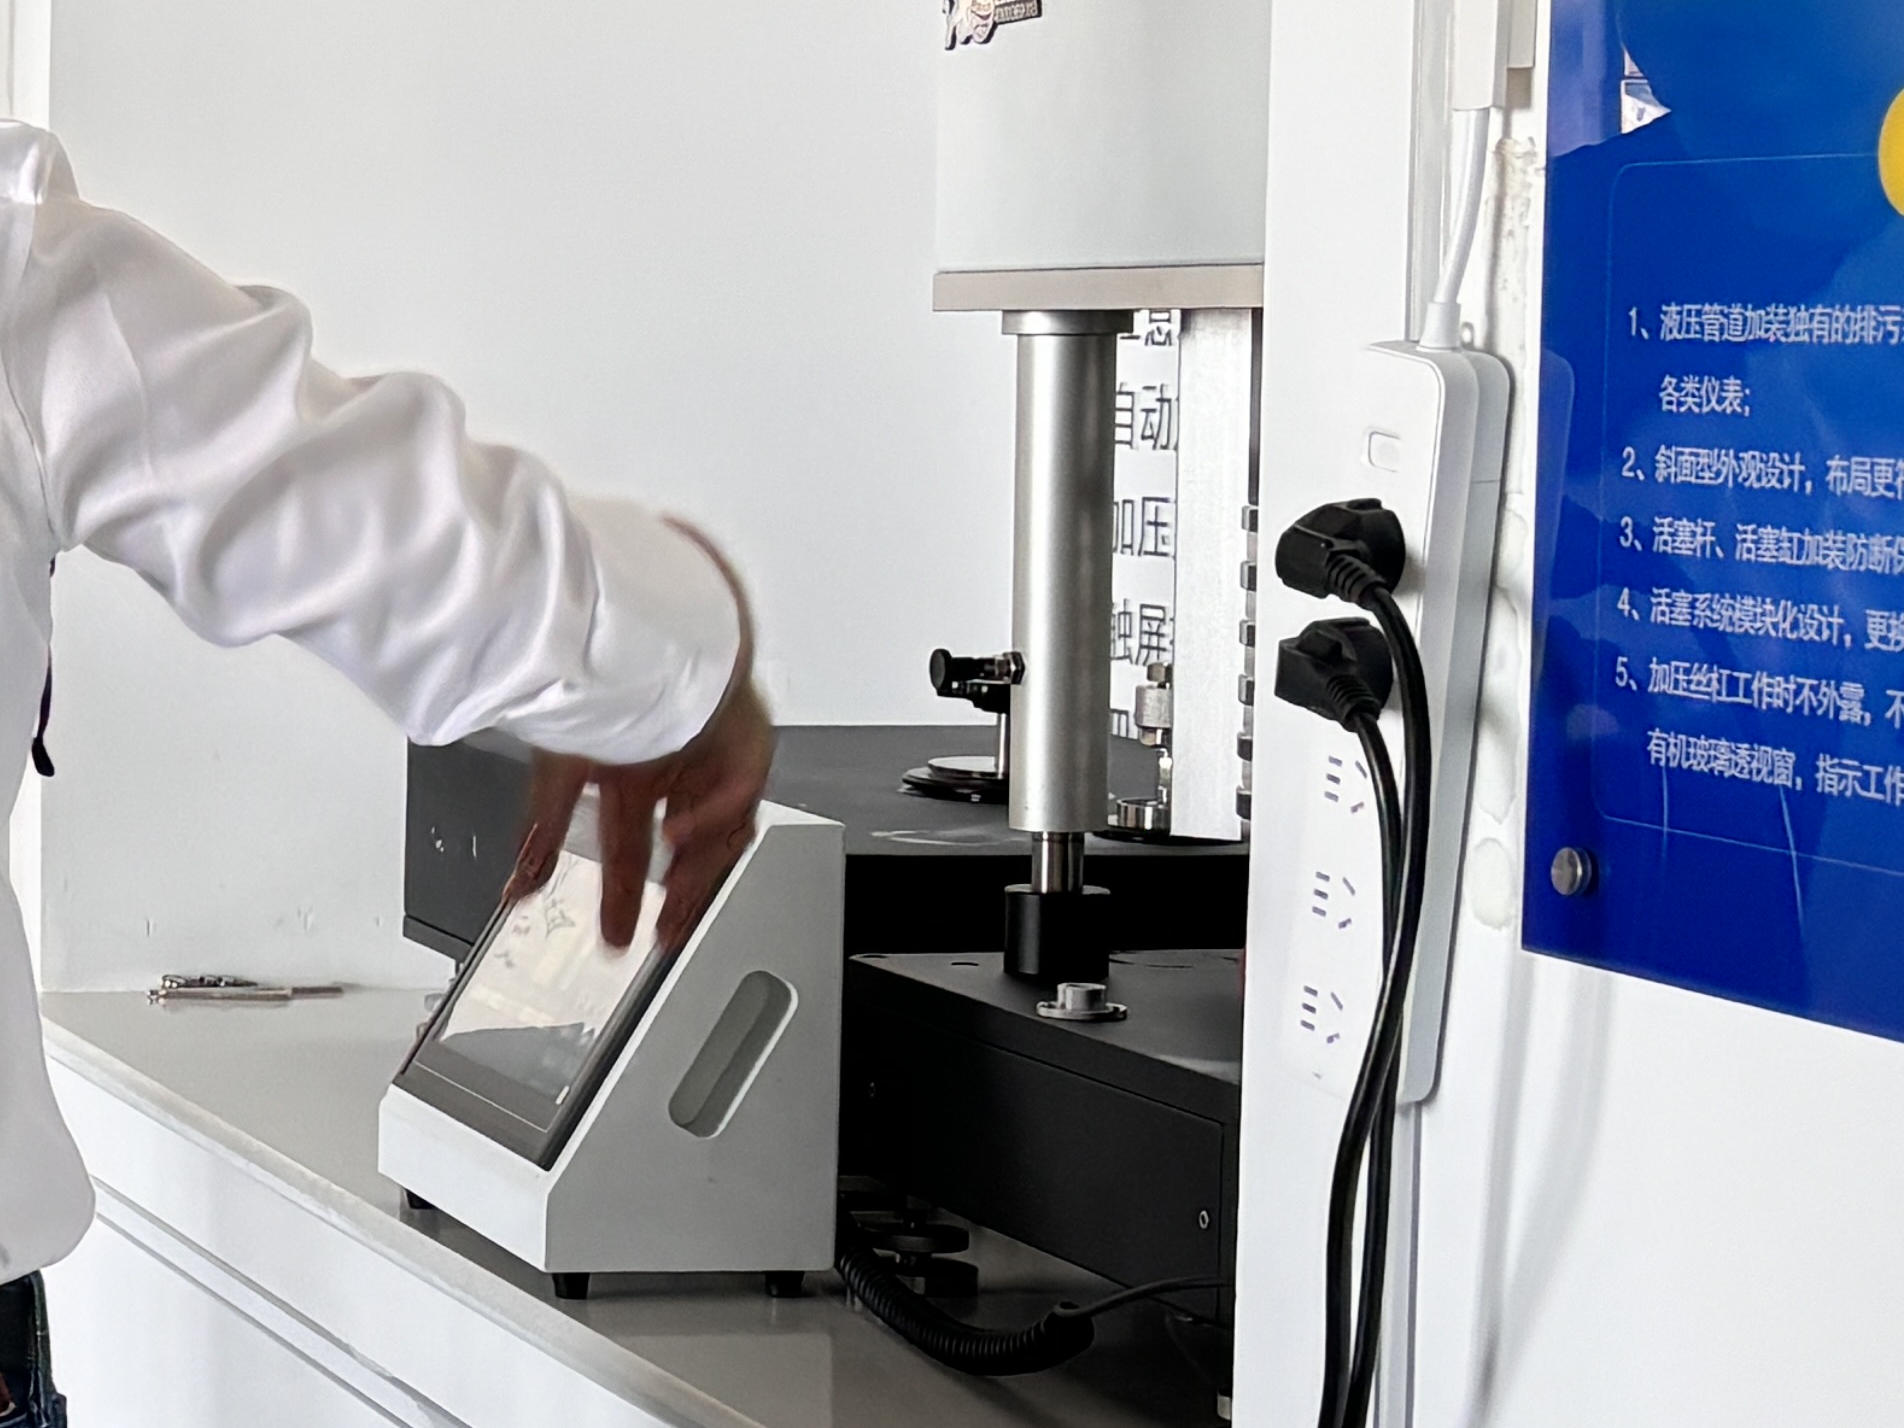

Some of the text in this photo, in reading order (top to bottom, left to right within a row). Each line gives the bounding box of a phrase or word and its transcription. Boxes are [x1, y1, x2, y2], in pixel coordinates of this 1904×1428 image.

[1629, 303, 1904, 346] 1、液压管道加装独有的排污
[1114, 382, 1179, 451] 自动
